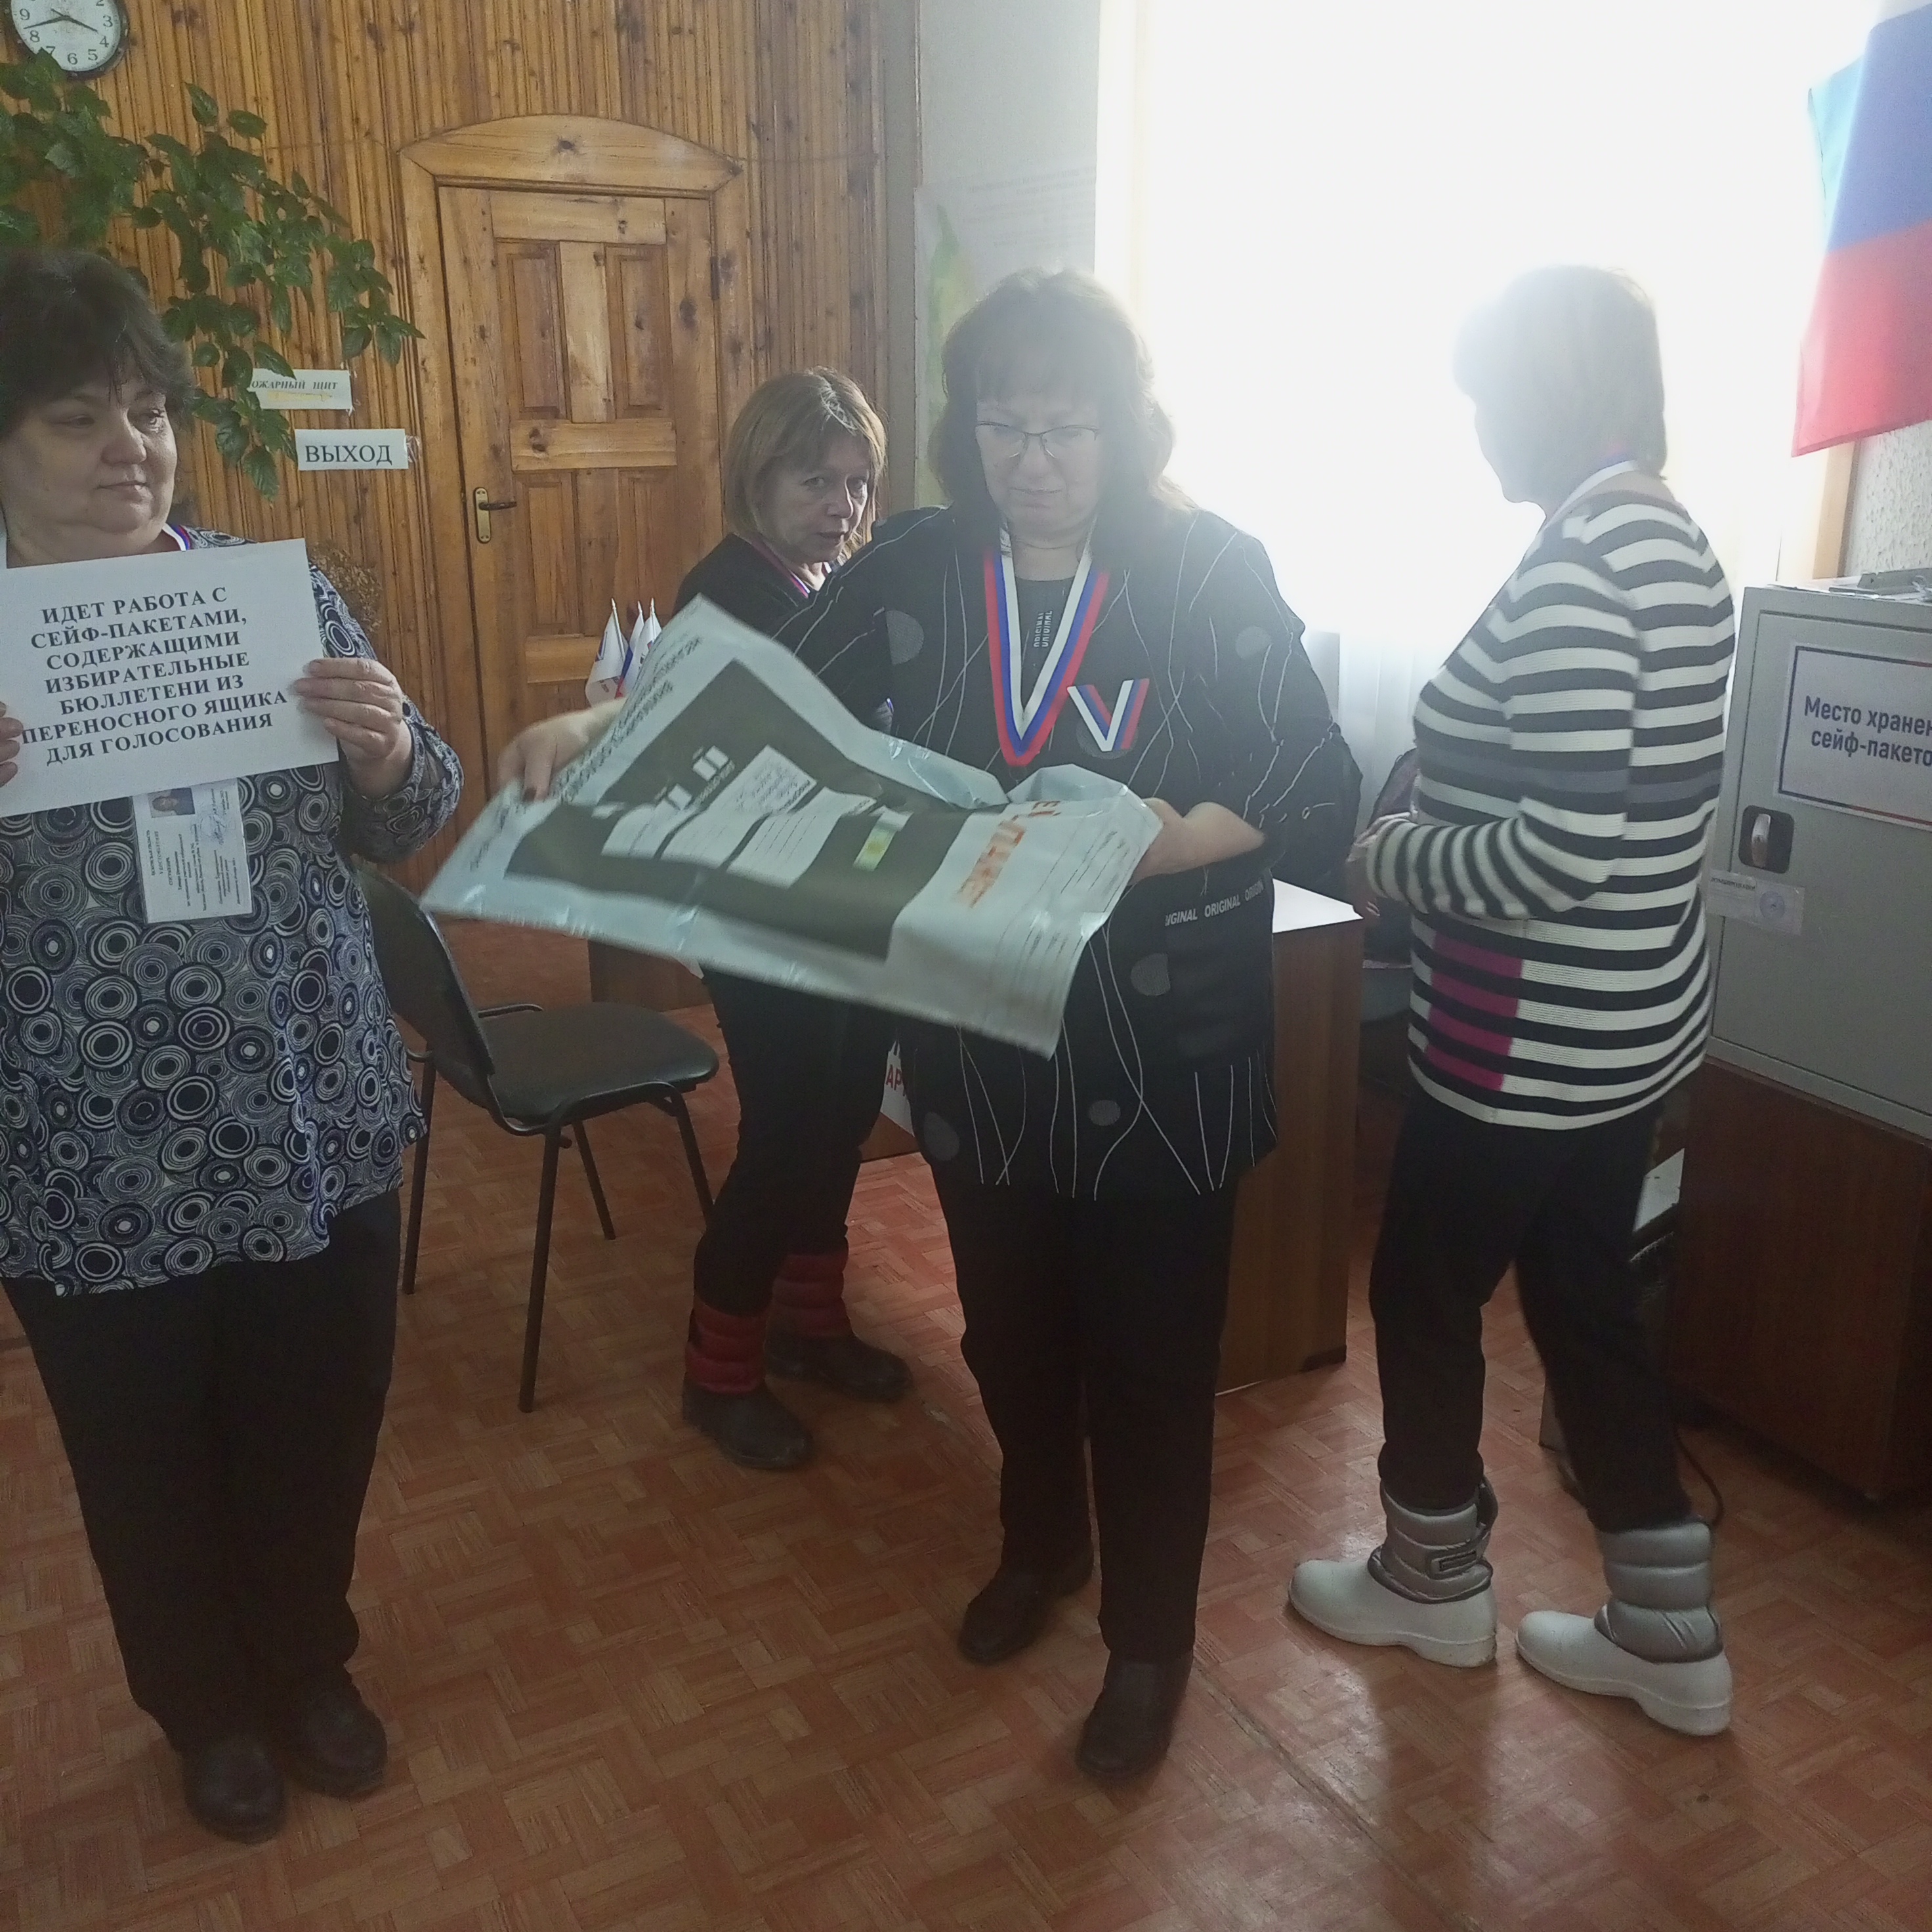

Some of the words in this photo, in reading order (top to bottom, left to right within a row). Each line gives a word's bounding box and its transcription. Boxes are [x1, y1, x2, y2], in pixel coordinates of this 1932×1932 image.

[20, 9, 30, 20] 9
[102, 15, 113, 28] 3
[30, 30, 40, 43] 8
[99, 36, 109, 48] 4
[67, 52, 78, 65] 6
[87, 49, 98, 61] 5
[251, 379, 306, 390] ОЖАРНЫЙ
[312, 381, 339, 390] ЩИТ
[305, 445, 392, 466] ВЫХОД
[40, 602, 105, 625] ИДЕТ
[112, 590, 206, 615] РАБОТА
[212, 587, 228, 602] С
[31, 608, 247, 649] СЕЙФ-ПАКЕТАМИ,
[47, 631, 241, 670] СОДЕРЖАЩИМИ
[44, 652, 250, 694] ИЗБИРАТЕЛЬНЫЕ
[59, 679, 211, 715] БЮЛЛЕТЕНИ
[216, 675, 244, 691] ИЗ
[22, 703, 198, 744] ПЕРЕНОСНОГО
[204, 690, 288, 715] ЯЩИКА
[1804, 695, 1862, 725] Место
[47, 742, 95, 767] ДЛЯ
[100, 713, 274, 754] ГОЛОСОВАНИЯ
[1204, 894, 1241, 918] ORIGINAL
